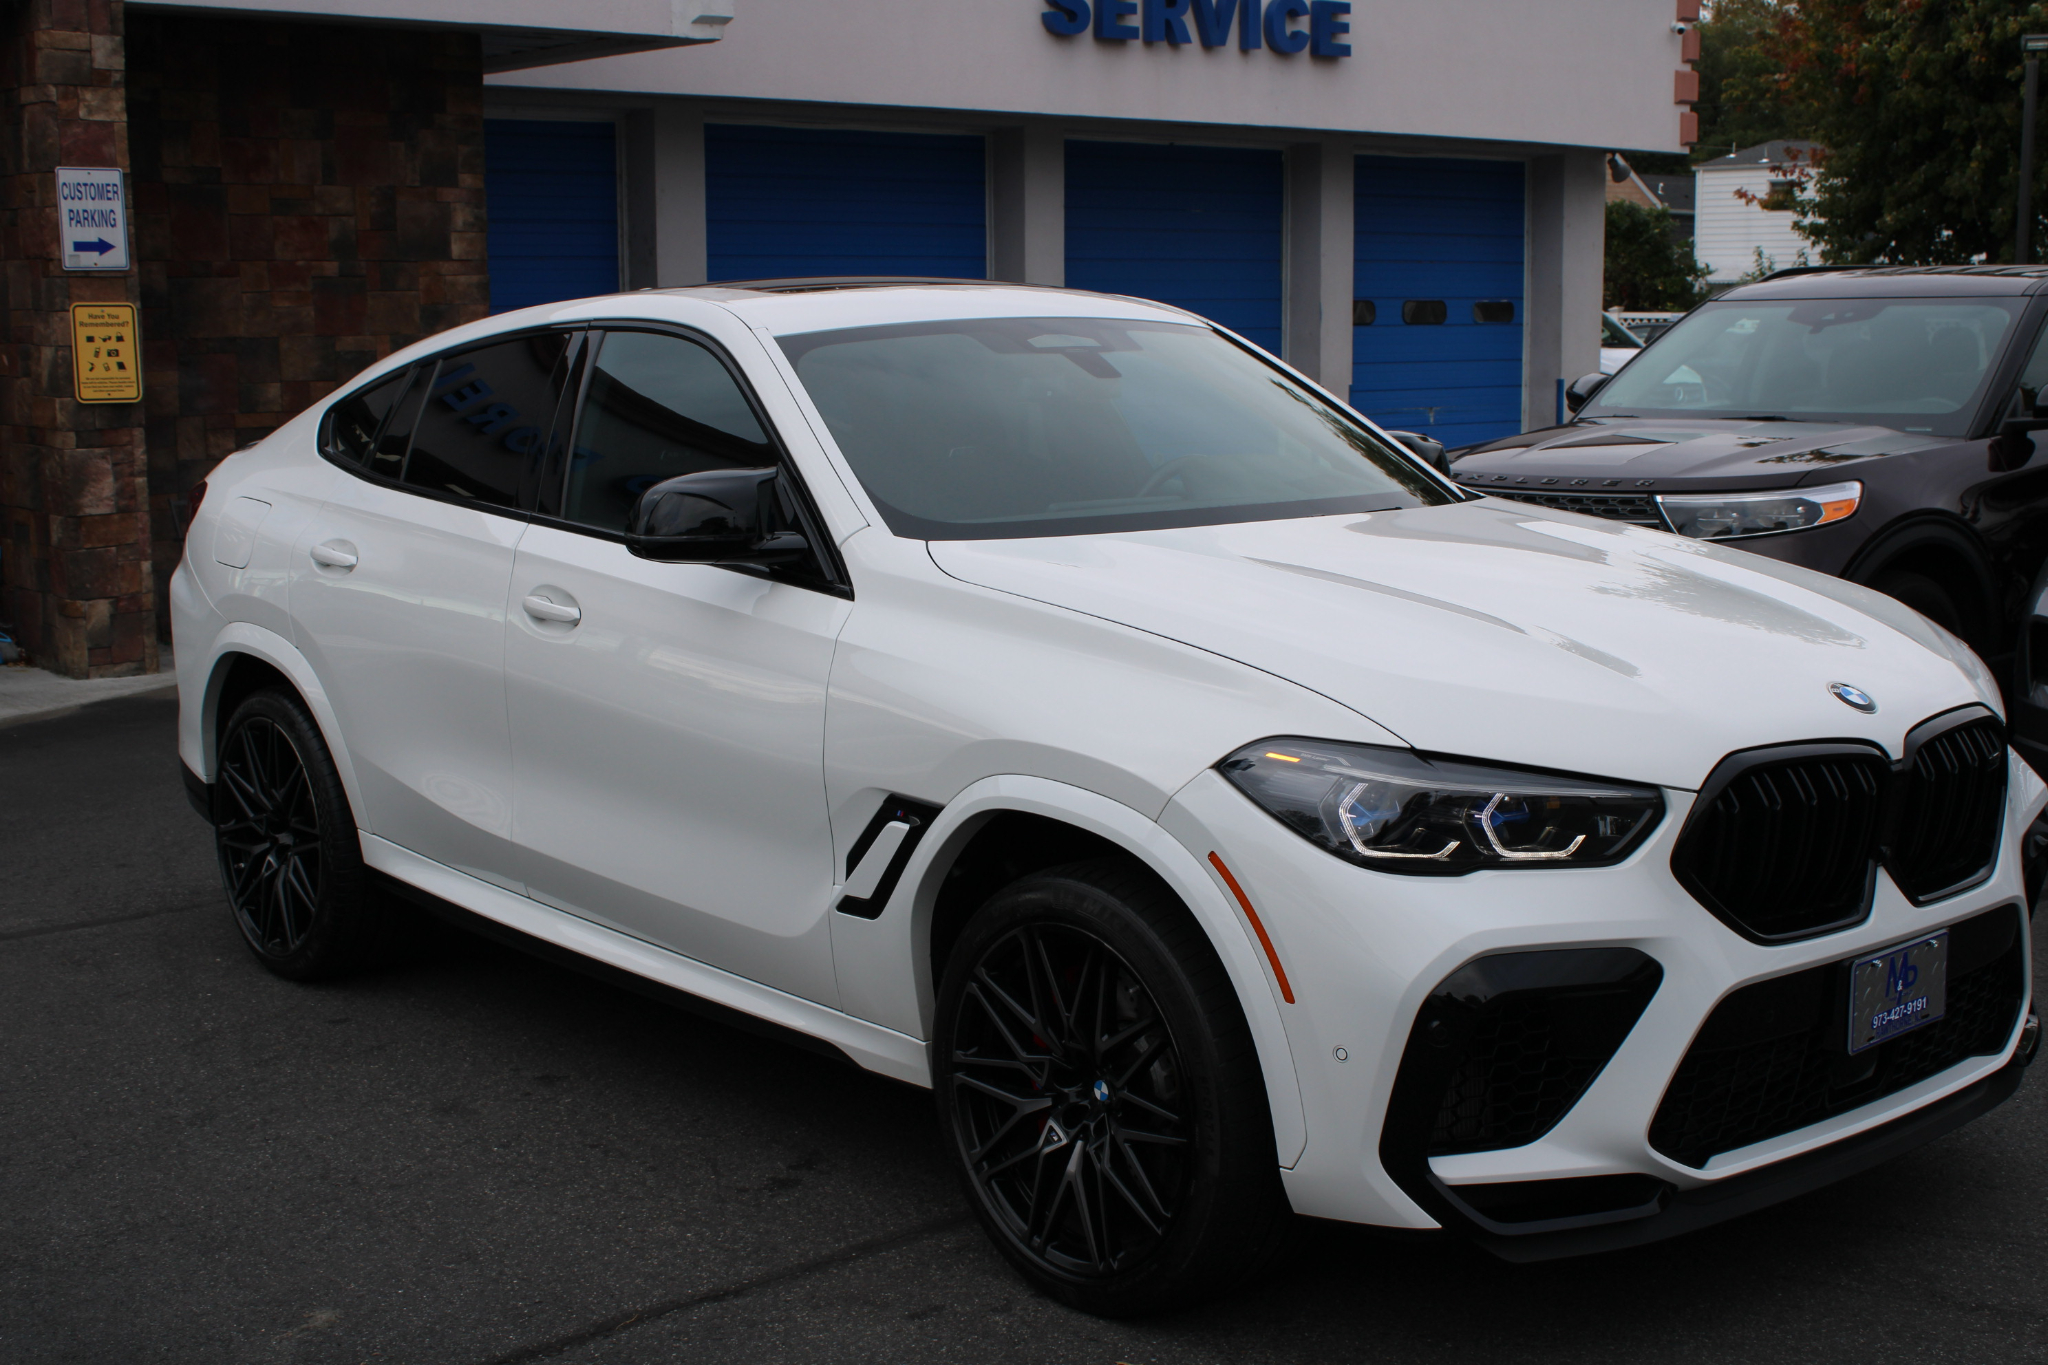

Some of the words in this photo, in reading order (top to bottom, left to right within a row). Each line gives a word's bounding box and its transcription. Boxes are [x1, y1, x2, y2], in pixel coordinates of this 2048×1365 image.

[1041, 0, 1352, 57] SERVICE
[61, 181, 120, 201] CUSTOMER
[68, 208, 117, 228] PARKING
[1451, 472, 1656, 487] EXPLORER
[1872, 996, 1927, 1029] 973-427-9191
